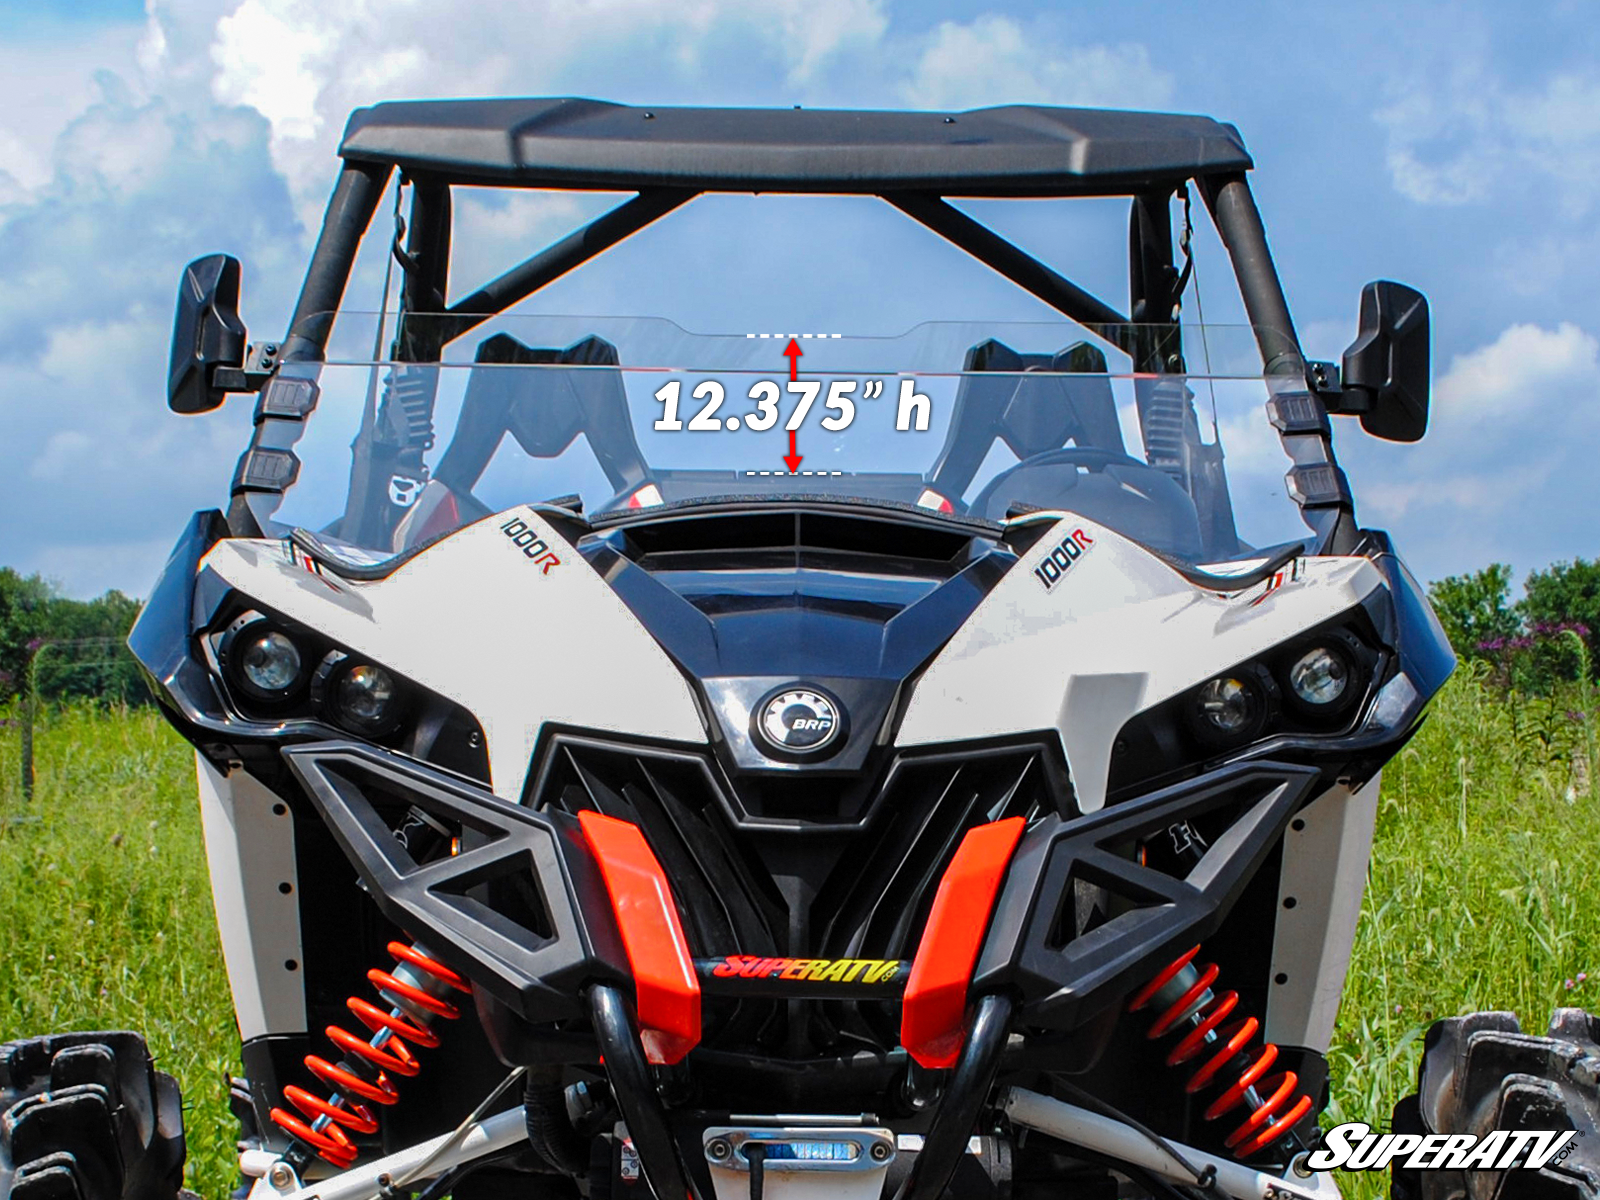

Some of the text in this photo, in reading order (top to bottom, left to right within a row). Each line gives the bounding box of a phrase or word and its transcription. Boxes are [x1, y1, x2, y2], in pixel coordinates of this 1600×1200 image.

[500, 517, 561, 575] 1000R
[1034, 529, 1093, 589] 1000R
[792, 718, 832, 731] BRP
